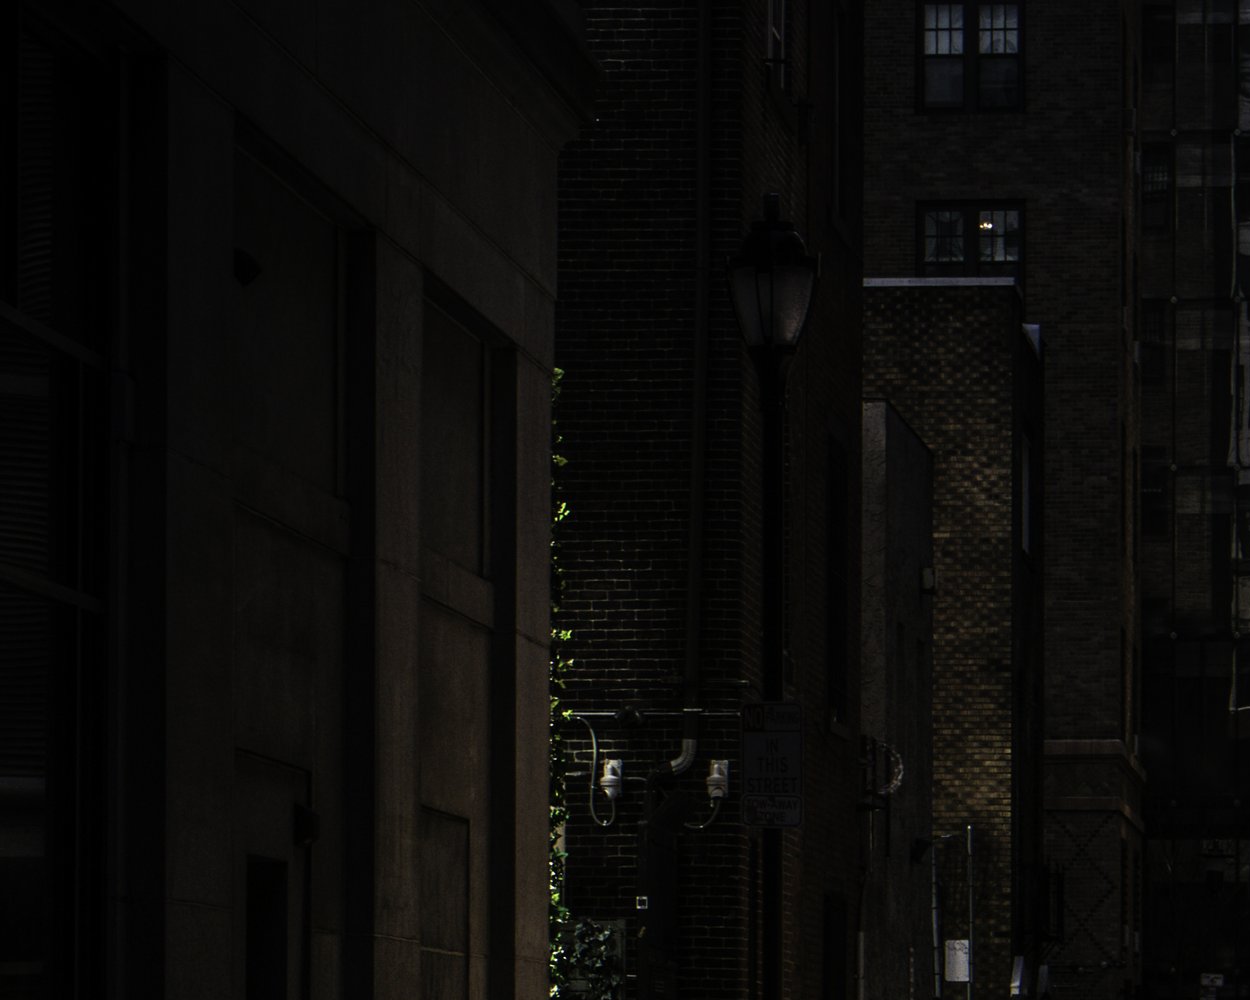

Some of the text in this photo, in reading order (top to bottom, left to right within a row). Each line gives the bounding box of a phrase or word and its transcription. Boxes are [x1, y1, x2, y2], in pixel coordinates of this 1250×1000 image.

[744, 707, 763, 729] NO
[766, 738, 779, 753] IN
[757, 757, 789, 773] THIS
[747, 777, 798, 793] STREET
[747, 799, 799, 811] TOW-AWAY
[759, 811, 786, 823] ZONE
